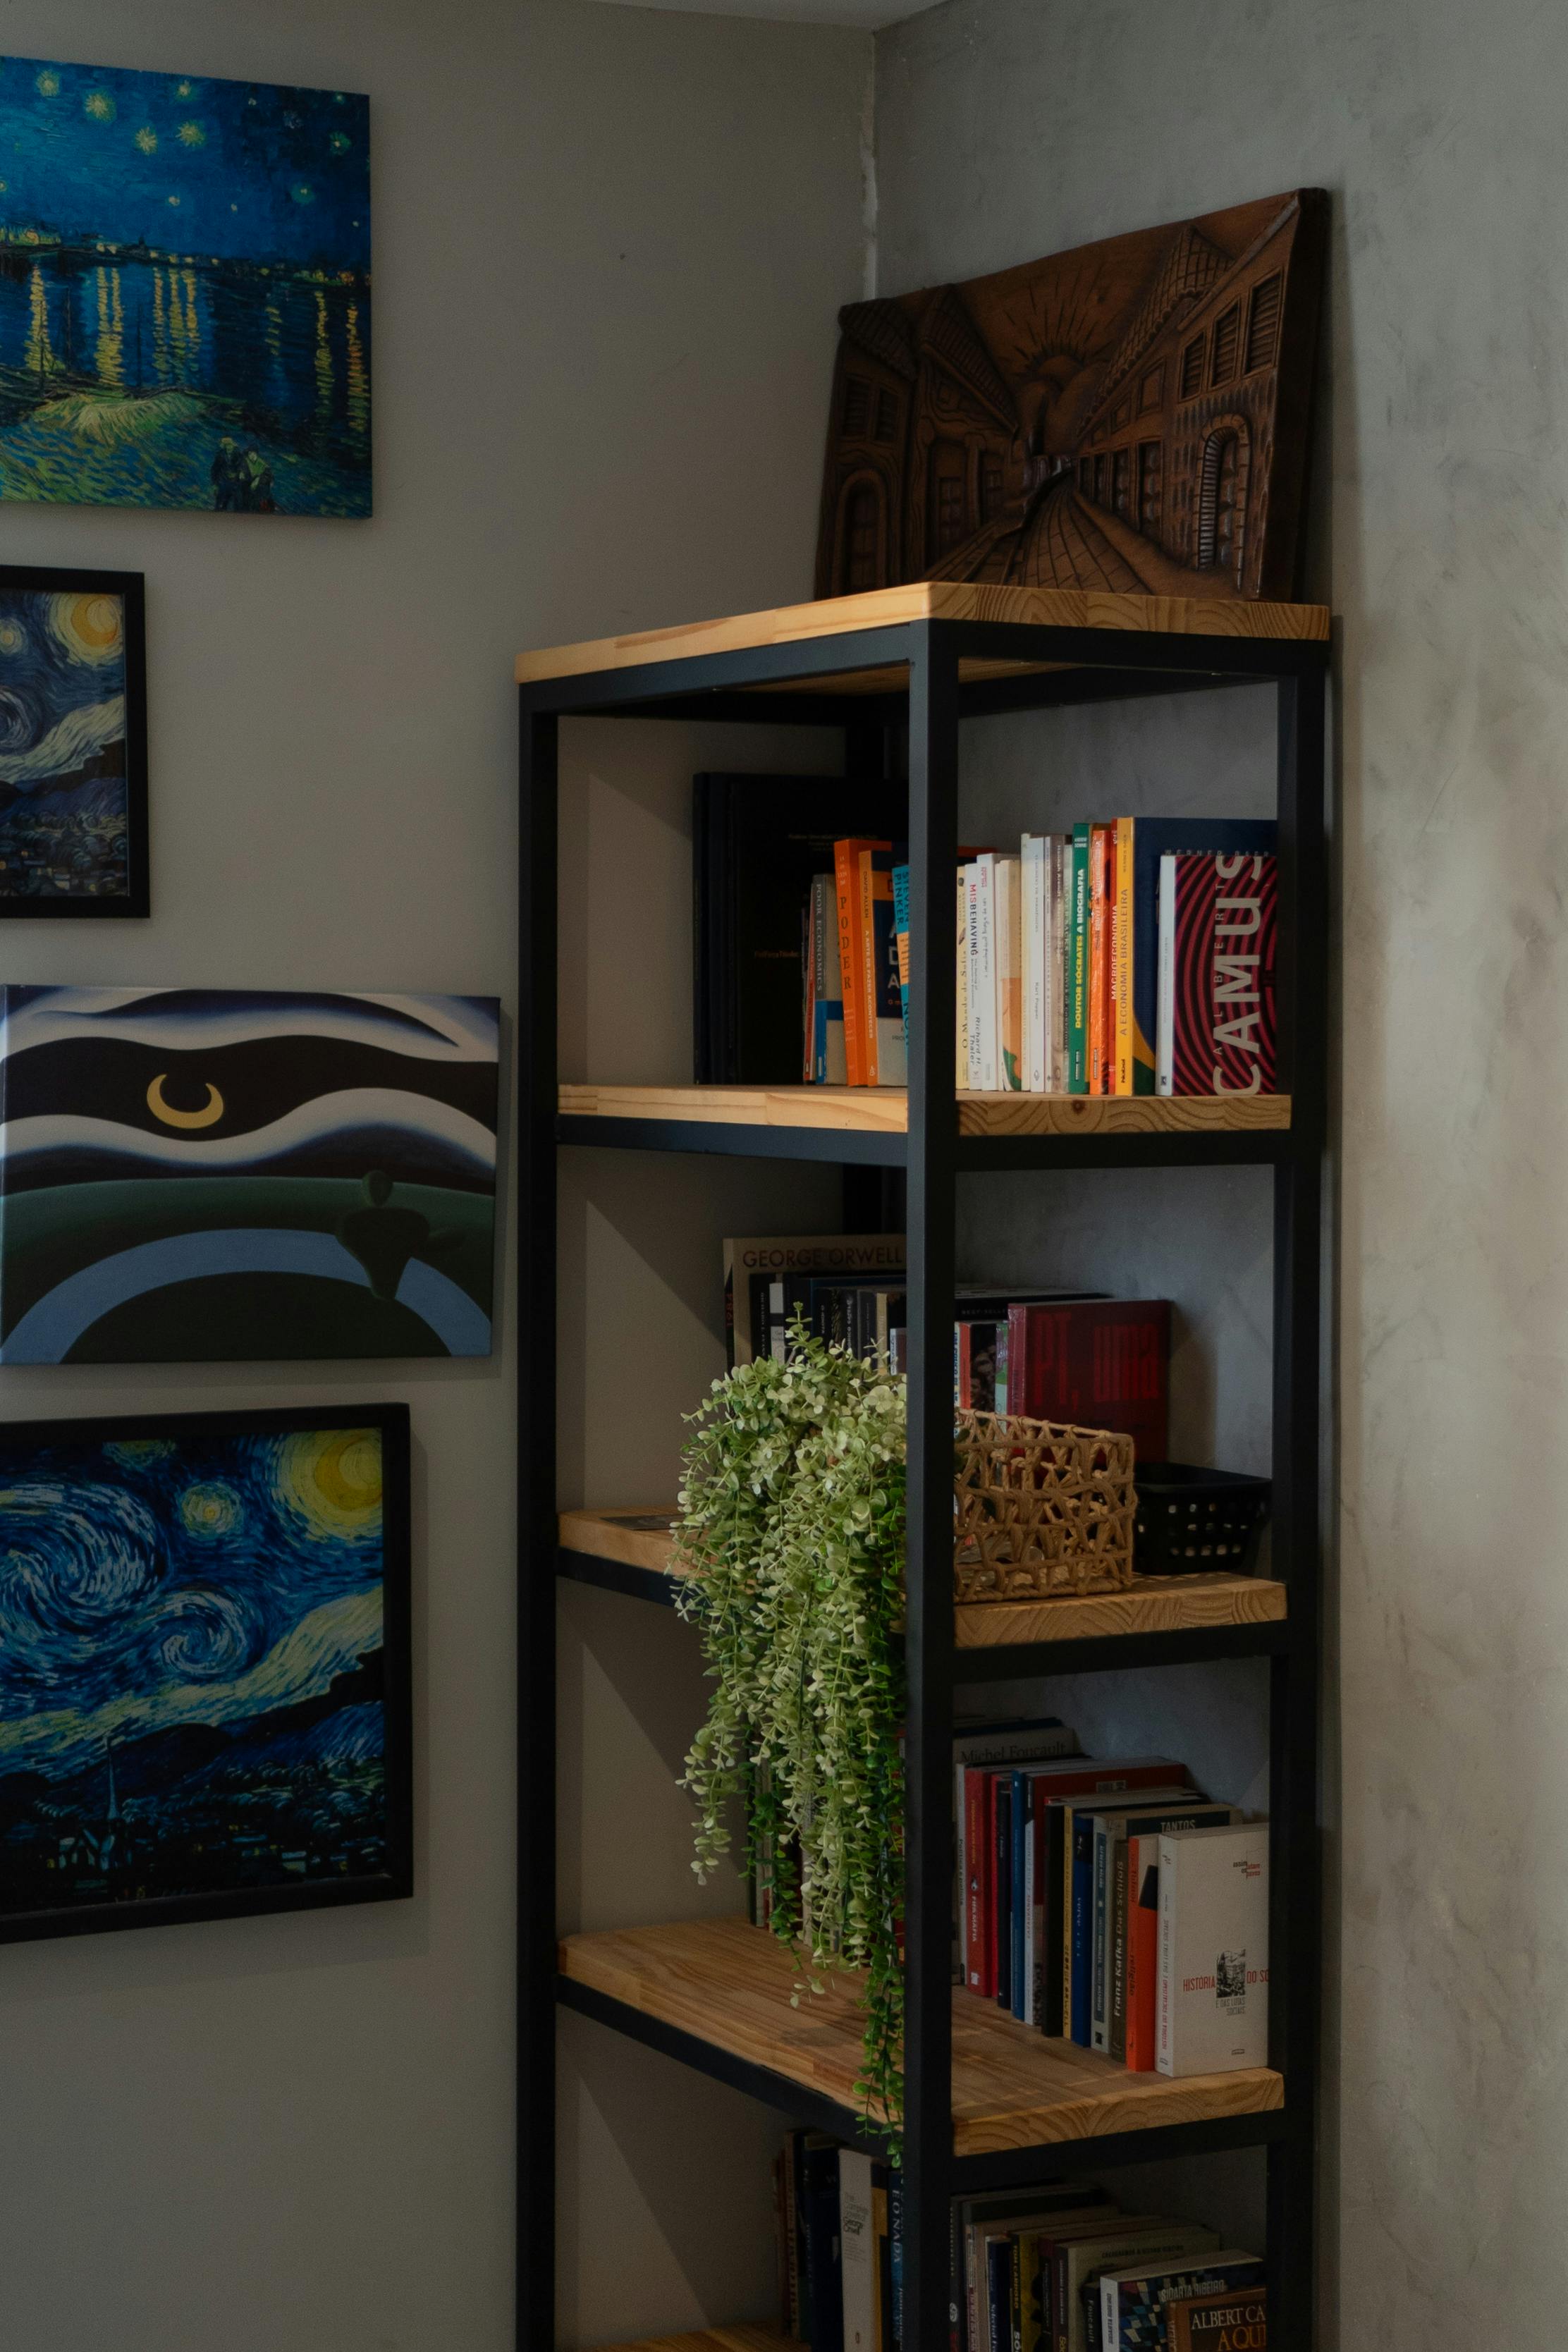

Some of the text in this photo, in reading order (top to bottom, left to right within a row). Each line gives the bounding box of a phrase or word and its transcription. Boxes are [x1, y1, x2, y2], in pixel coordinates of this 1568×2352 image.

[895, 873, 904, 926] PINKER
[815, 883, 823, 992] POOR ECONOMICS
[969, 883, 979, 956] MISBEHAVING
[1119, 888, 1128, 959] BRASILEIRA
[839, 896, 852, 991] PODER
[1074, 868, 1084, 1029] DOUTOR SÓCRATES A BIOGRAFIA
[1212, 856, 1263, 1096] CAMUS
[1213, 884, 1225, 1055] ALBERT
[1119, 962, 1128, 1024] ECONOMIA
[961, 1039, 968, 1048] O
[742, 1247, 902, 1268] GEORGE ORWELL
[961, 1741, 1067, 1761] Michel Foucault
[1160, 1818, 1196, 1833] TANTOS
[1114, 1937, 1122, 1977] Kafka
[1247, 1971, 1257, 1984] DO
[1113, 1979, 1122, 2016] Franz
[1220, 1998, 1230, 2008] DAS
[1160, 2279, 1225, 2303] SIDARTA RIBEIRO
[1191, 2307, 1244, 2330] ALBERT
[1218, 2329, 1231, 2351] A
